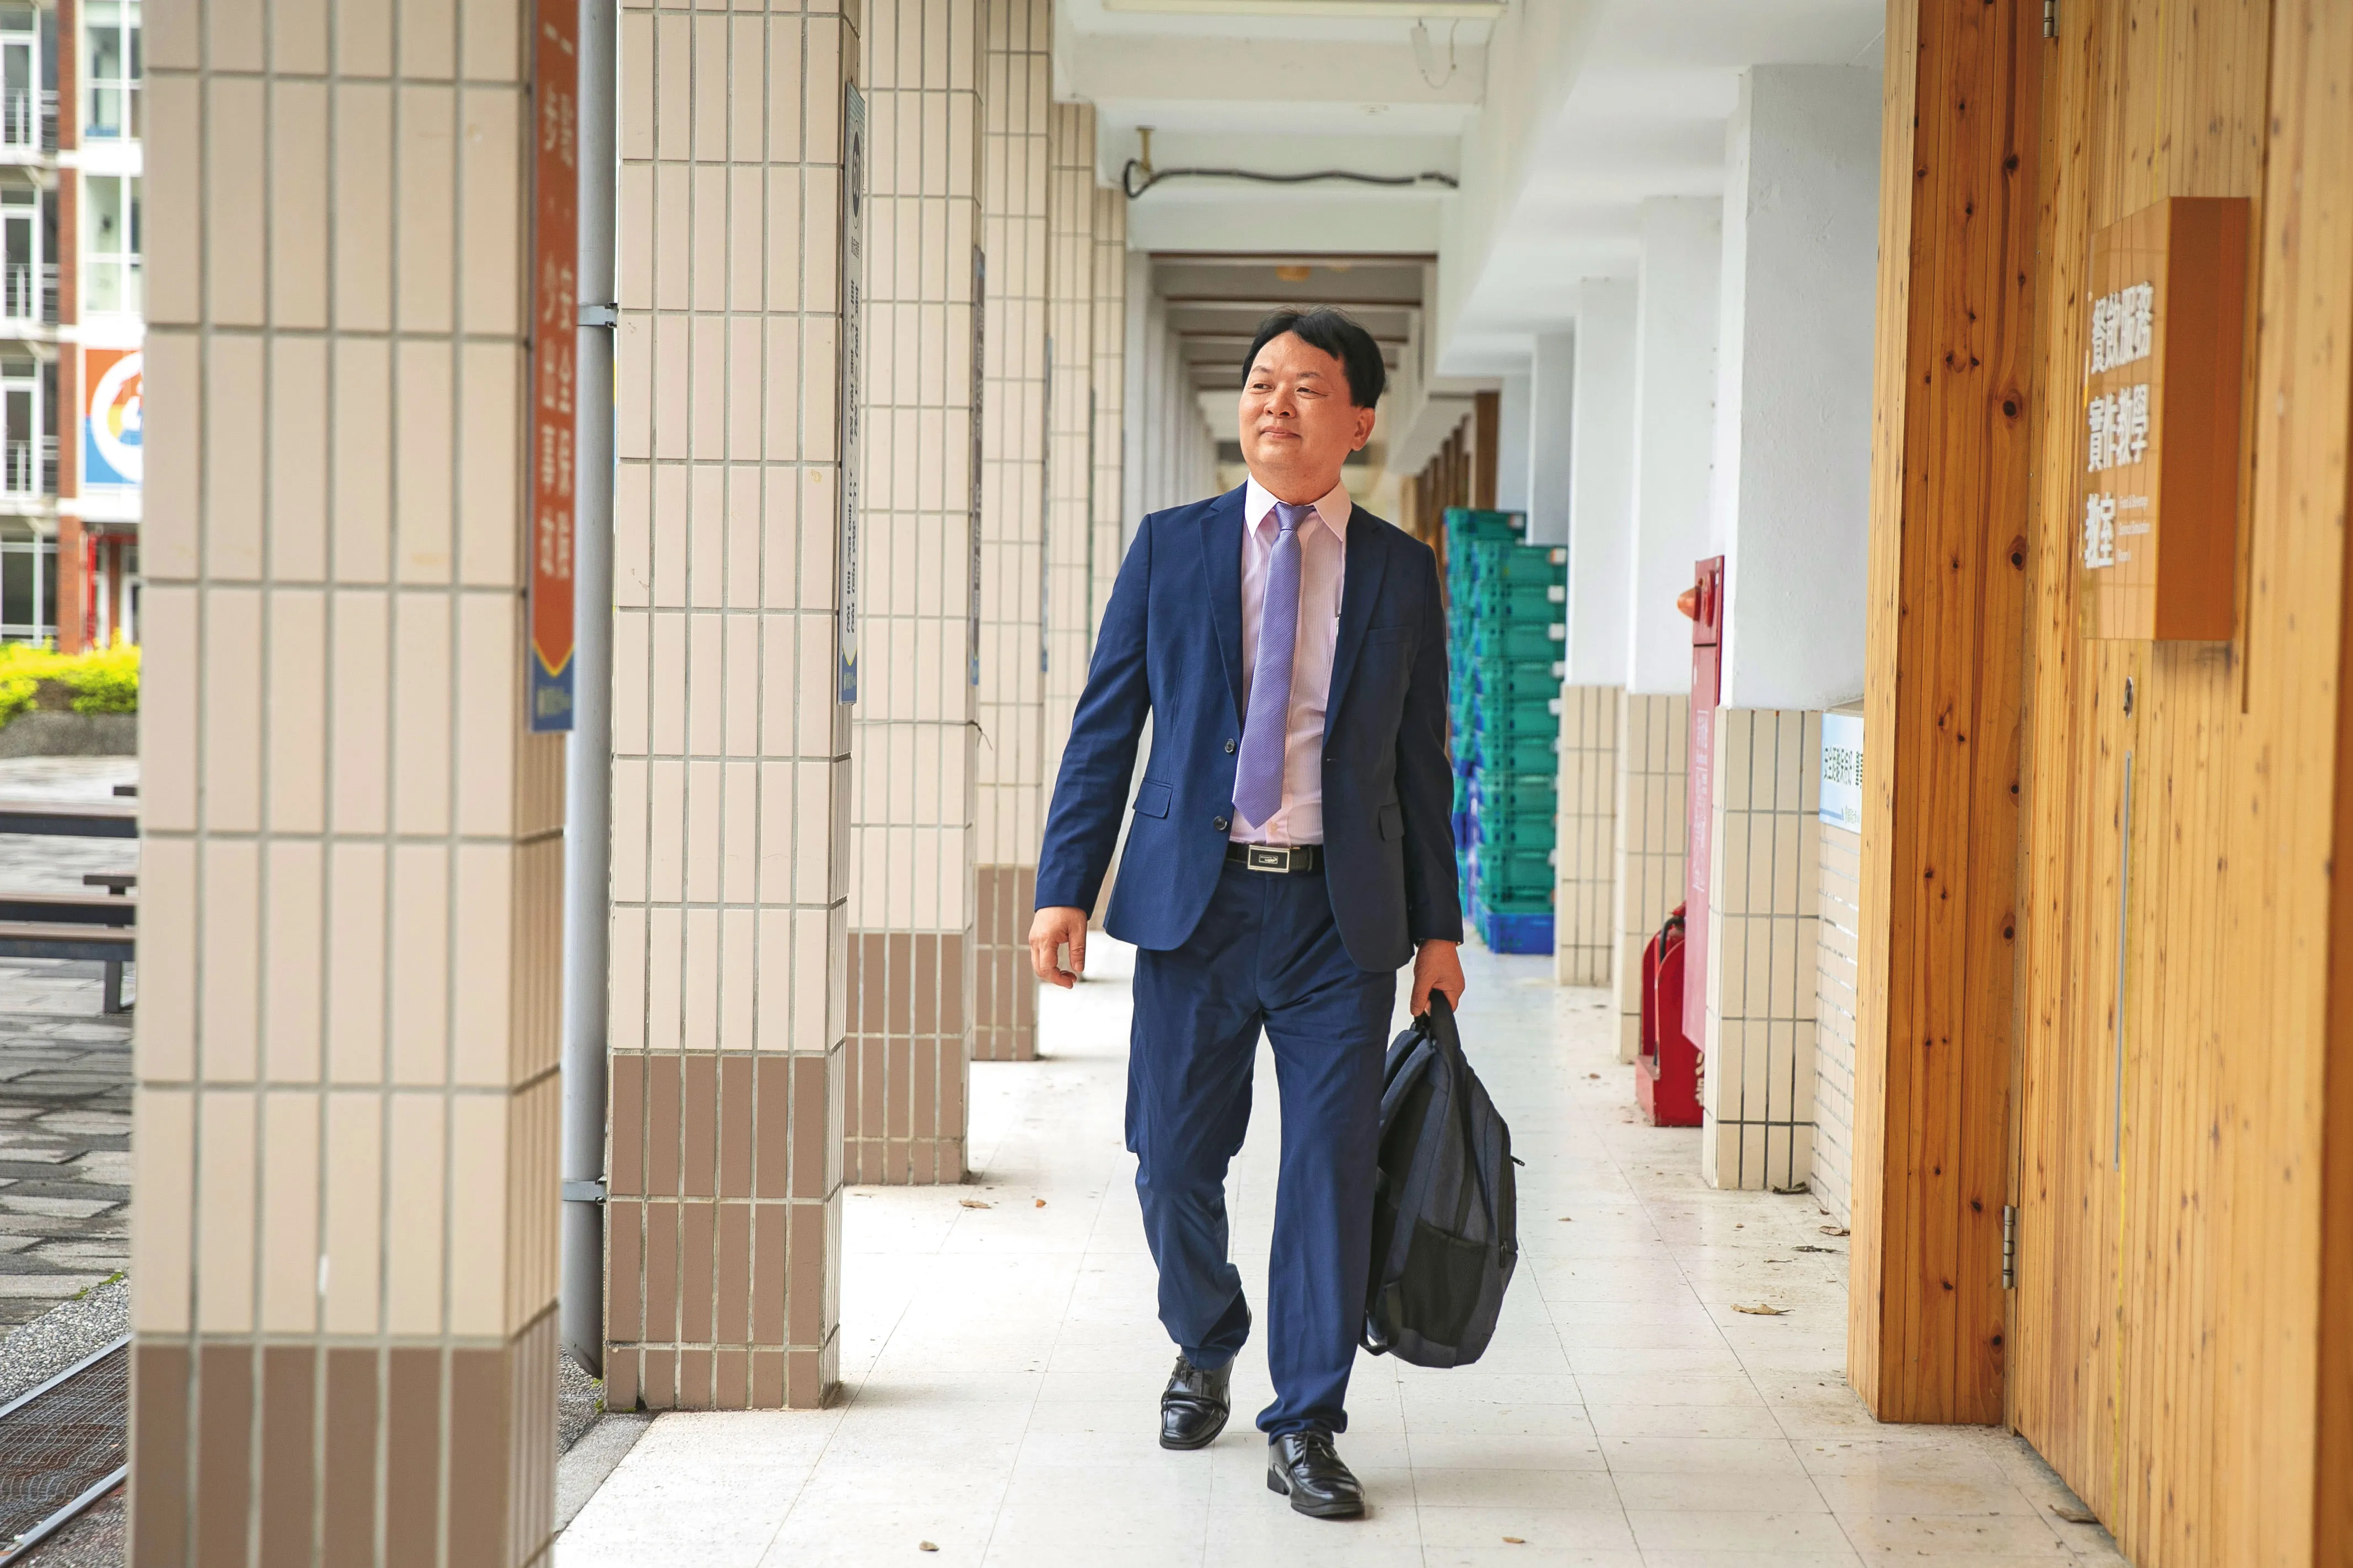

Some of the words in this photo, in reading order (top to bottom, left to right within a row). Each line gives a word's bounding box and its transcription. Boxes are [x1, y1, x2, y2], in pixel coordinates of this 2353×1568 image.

[853, 151, 859, 198] 60
[2091, 281, 2153, 375] 餐飲服務
[2088, 384, 2149, 472] 實作教學
[2085, 491, 2115, 568] 教室
[2119, 522, 2131, 536] Service
[2120, 495, 2128, 509] Food
[2132, 494, 2148, 512] Beverage
